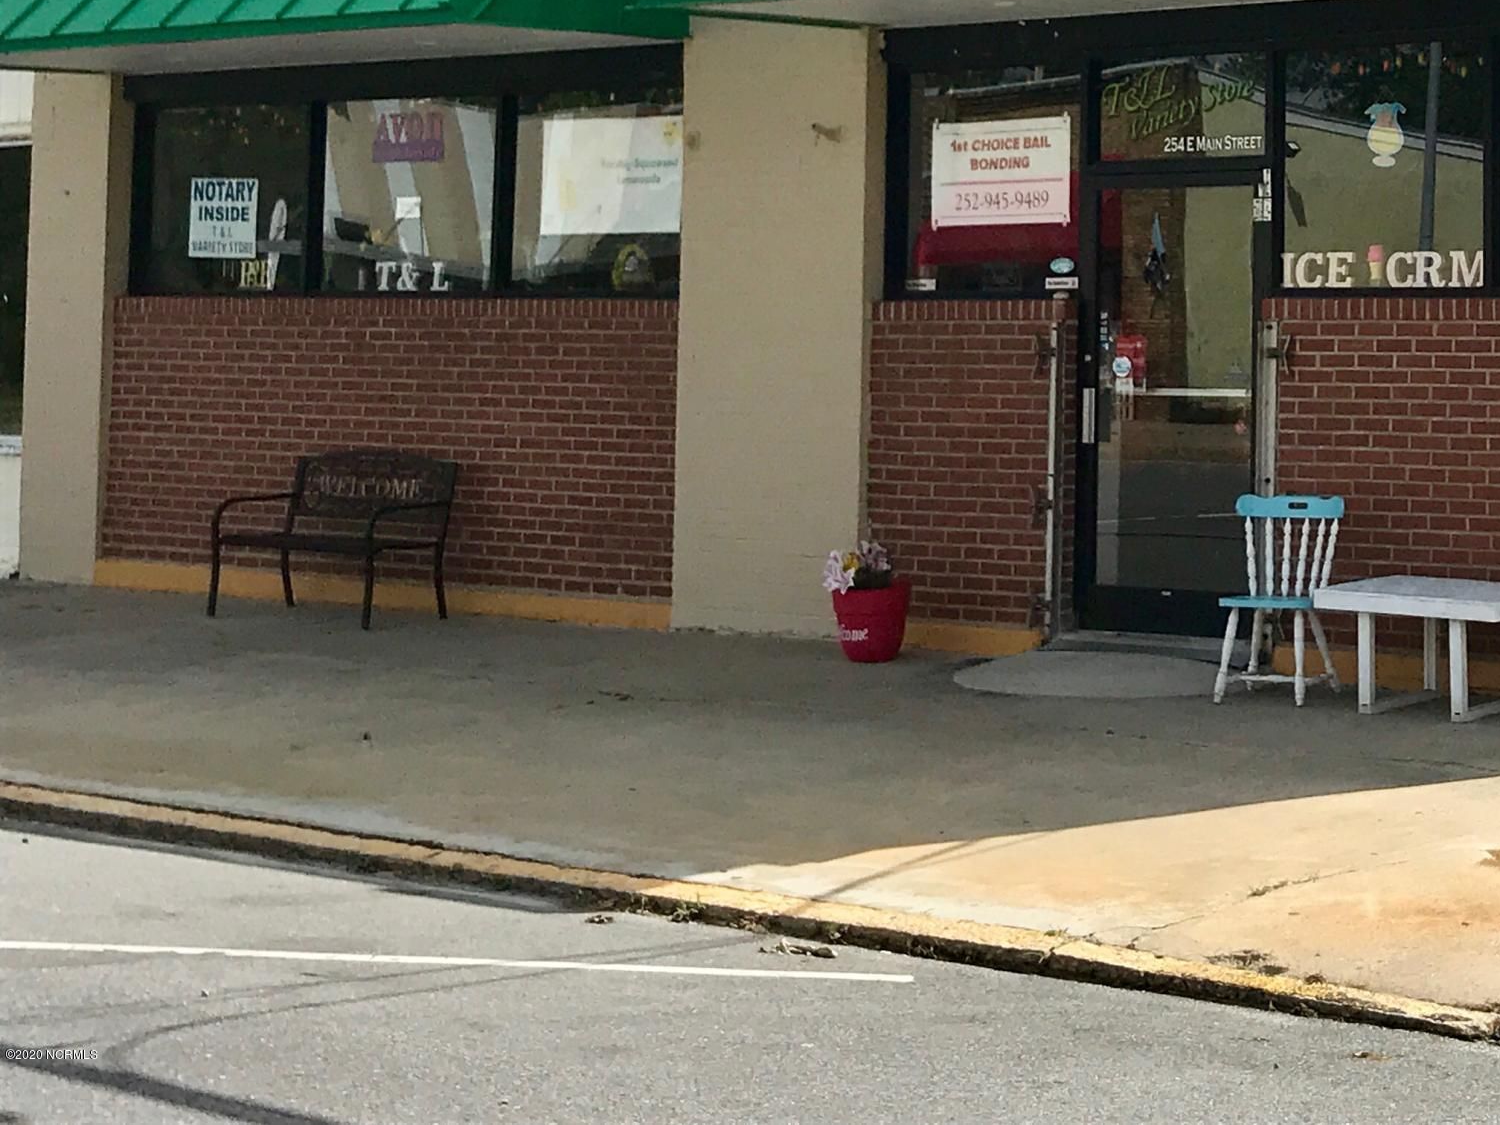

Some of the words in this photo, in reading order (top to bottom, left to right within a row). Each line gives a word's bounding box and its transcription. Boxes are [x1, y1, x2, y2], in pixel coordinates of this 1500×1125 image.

[951, 139, 968, 152] 1st
[971, 137, 1020, 152] CHOICE
[1023, 135, 1052, 149] BAIL
[1163, 137, 1185, 153] 254
[1186, 137, 1195, 152] E
[970, 156, 1030, 171] BONDING
[193, 180, 256, 202] NOTARY
[954, 189, 1050, 211] 252-945-9489
[198, 206, 250, 222] INSIDE
[1281, 251, 1355, 288] ICE
[1386, 250, 1485, 288] CRM
